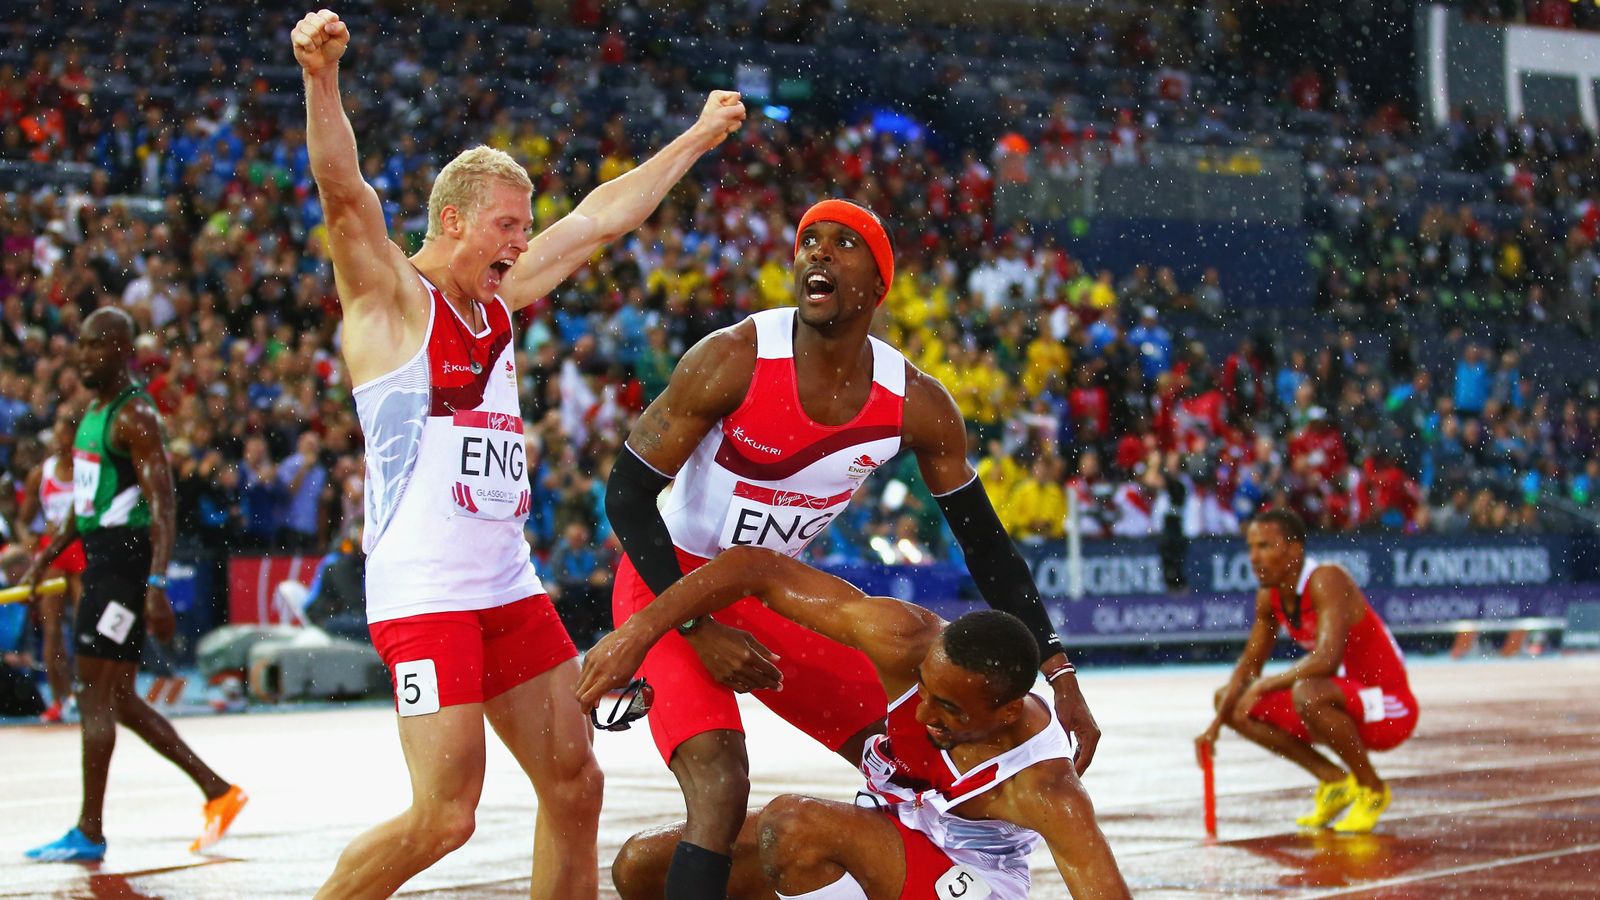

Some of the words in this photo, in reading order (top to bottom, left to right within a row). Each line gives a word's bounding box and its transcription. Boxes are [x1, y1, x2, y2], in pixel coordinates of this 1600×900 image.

[452, 364, 472, 372] KUK
[461, 436, 523, 481] ENG
[743, 436, 782, 456] KUKRI
[731, 508, 834, 545] ENG
[1393, 547, 1551, 587] LONGINES
[110, 613, 124, 633] 2
[403, 673, 421, 705] 5
[948, 871, 974, 899] 5
